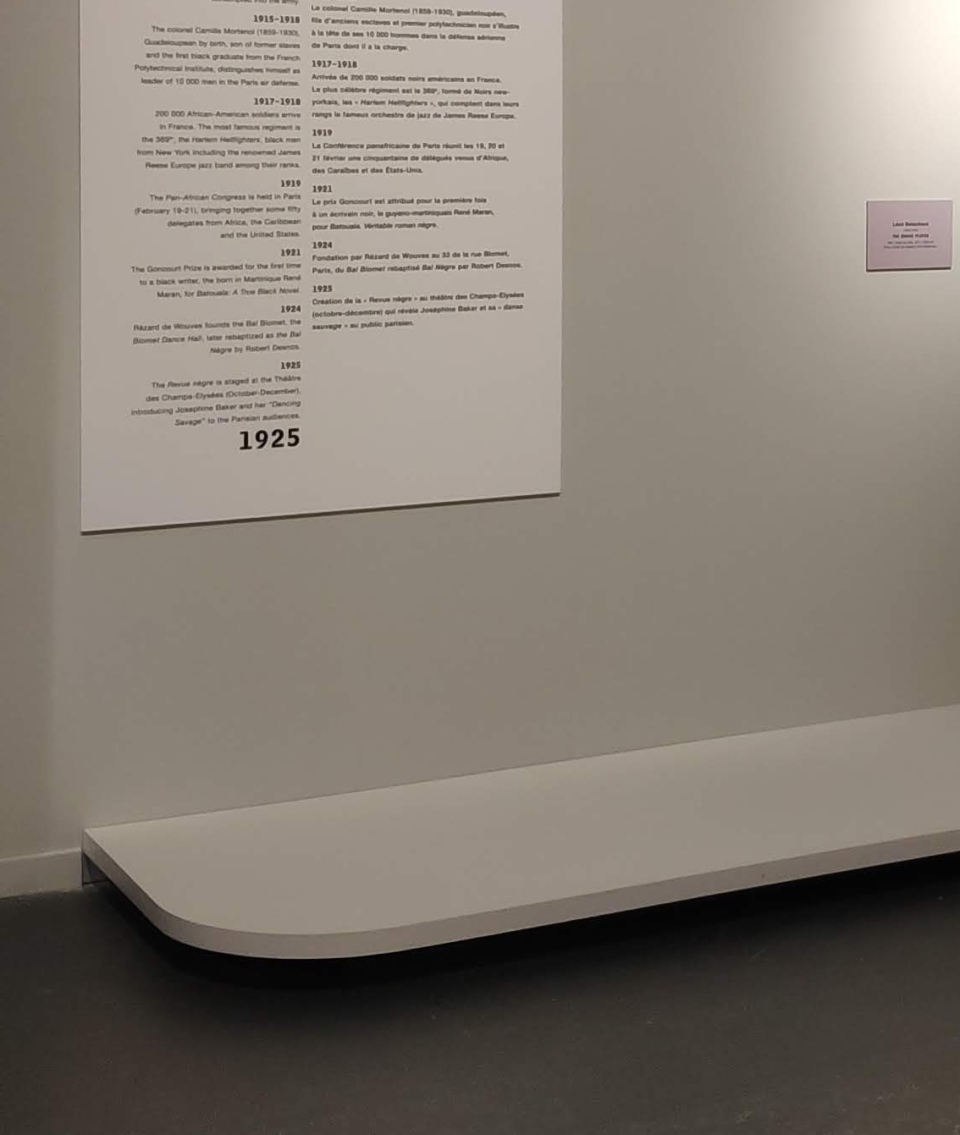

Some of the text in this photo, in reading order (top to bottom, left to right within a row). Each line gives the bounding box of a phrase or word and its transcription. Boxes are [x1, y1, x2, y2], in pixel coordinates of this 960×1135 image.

[312, 129, 332, 137] 1919
[280, 179, 301, 188] 1919
[312, 185, 332, 193] 1921
[312, 241, 332, 249] 1924
[280, 248, 300, 257] 1921
[312, 285, 332, 293] 1925
[280, 304, 301, 313] 1924
[280, 361, 301, 370] 1925
[239, 428, 300, 450] 1925
